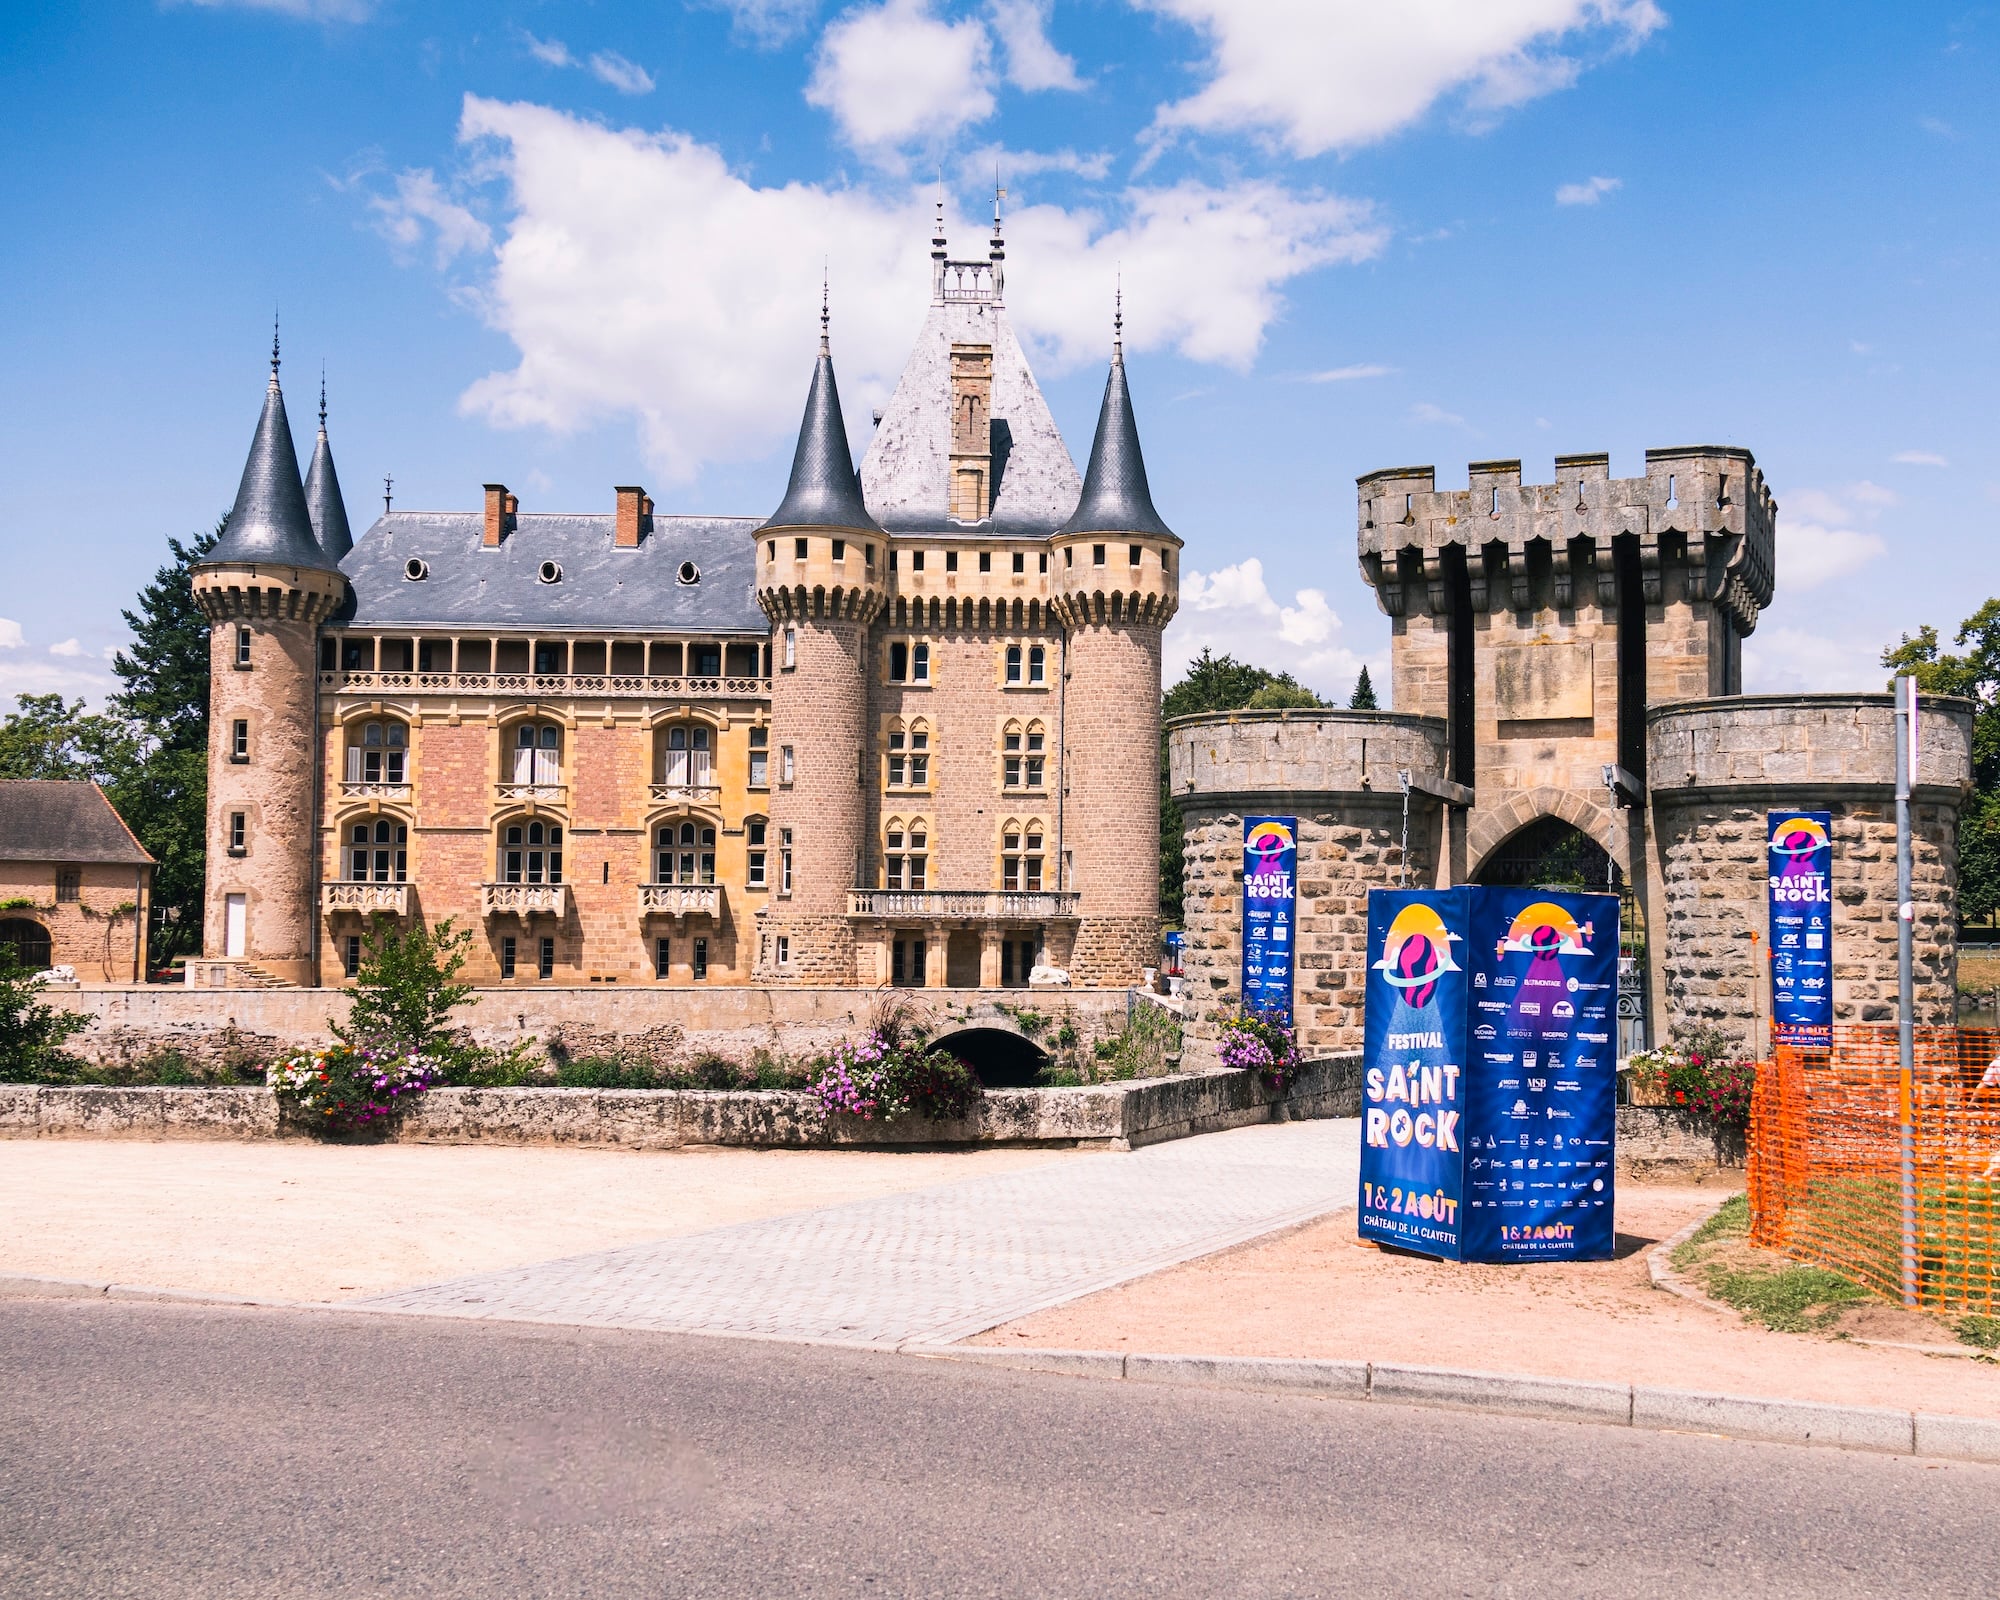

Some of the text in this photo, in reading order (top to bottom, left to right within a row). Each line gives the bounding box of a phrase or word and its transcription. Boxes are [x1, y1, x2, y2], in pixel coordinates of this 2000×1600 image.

[1388, 1031, 1443, 1050] FESTIVAL
[1527, 1078, 1547, 1088] MSB
[1366, 1107, 1460, 1153] ROCK
[1364, 1182, 1458, 1225] 1 & 2 AOÛT
[1363, 1215, 1397, 1231] CHÂTEAU
[1398, 1222, 1408, 1233] DE
[1410, 1225, 1420, 1236] LA
[1420, 1227, 1457, 1245] CLAYETTE
[1501, 1221, 1574, 1240] 1 & 2 AOÛT
